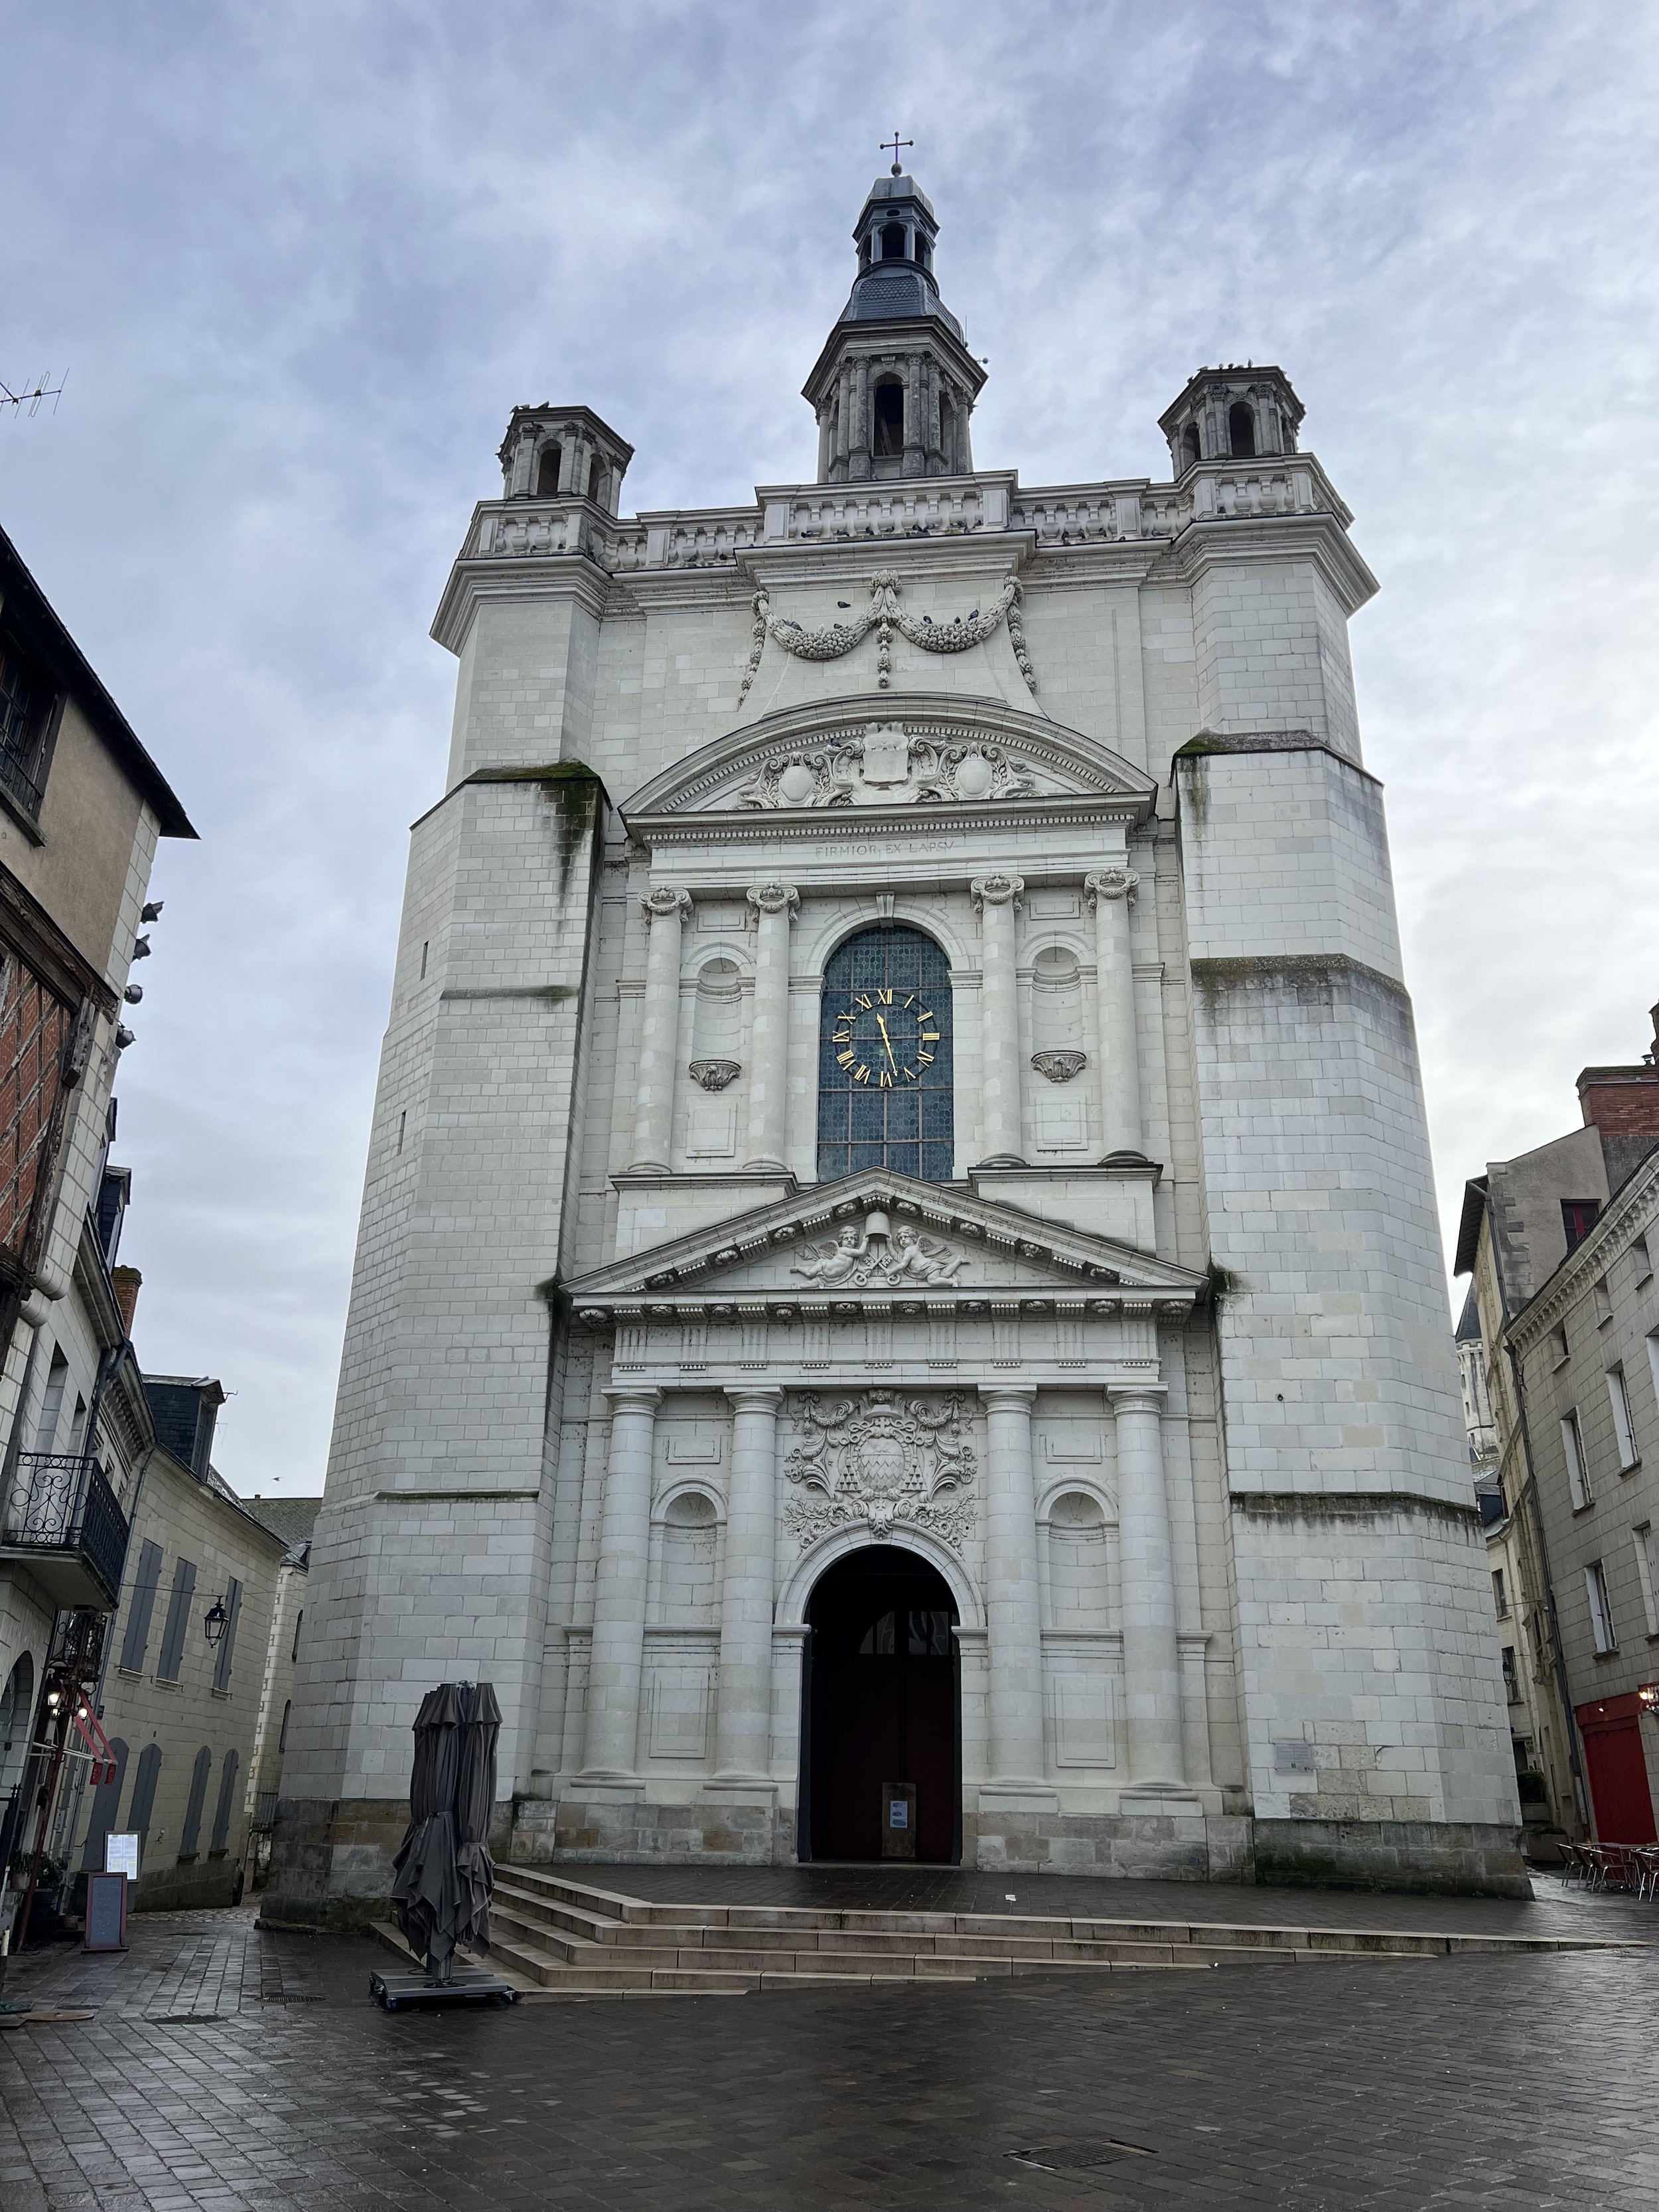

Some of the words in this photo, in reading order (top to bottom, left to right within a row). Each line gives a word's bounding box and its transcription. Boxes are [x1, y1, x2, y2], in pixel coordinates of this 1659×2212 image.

[886, 844, 901, 854] EX
[909, 841, 954, 853] LAPSV
[855, 994, 872, 1011] XI
[878, 990, 893, 1004] XII
[904, 995, 914, 1009] I
[837, 1011, 856, 1024] X
[917, 1011, 933, 1023] II
[833, 1030, 849, 1042] IX
[837, 1050, 855, 1070] VIII
[854, 1065, 871, 1084] VII
[881, 1071, 893, 1087] VI
[904, 1067, 916, 1082] V
